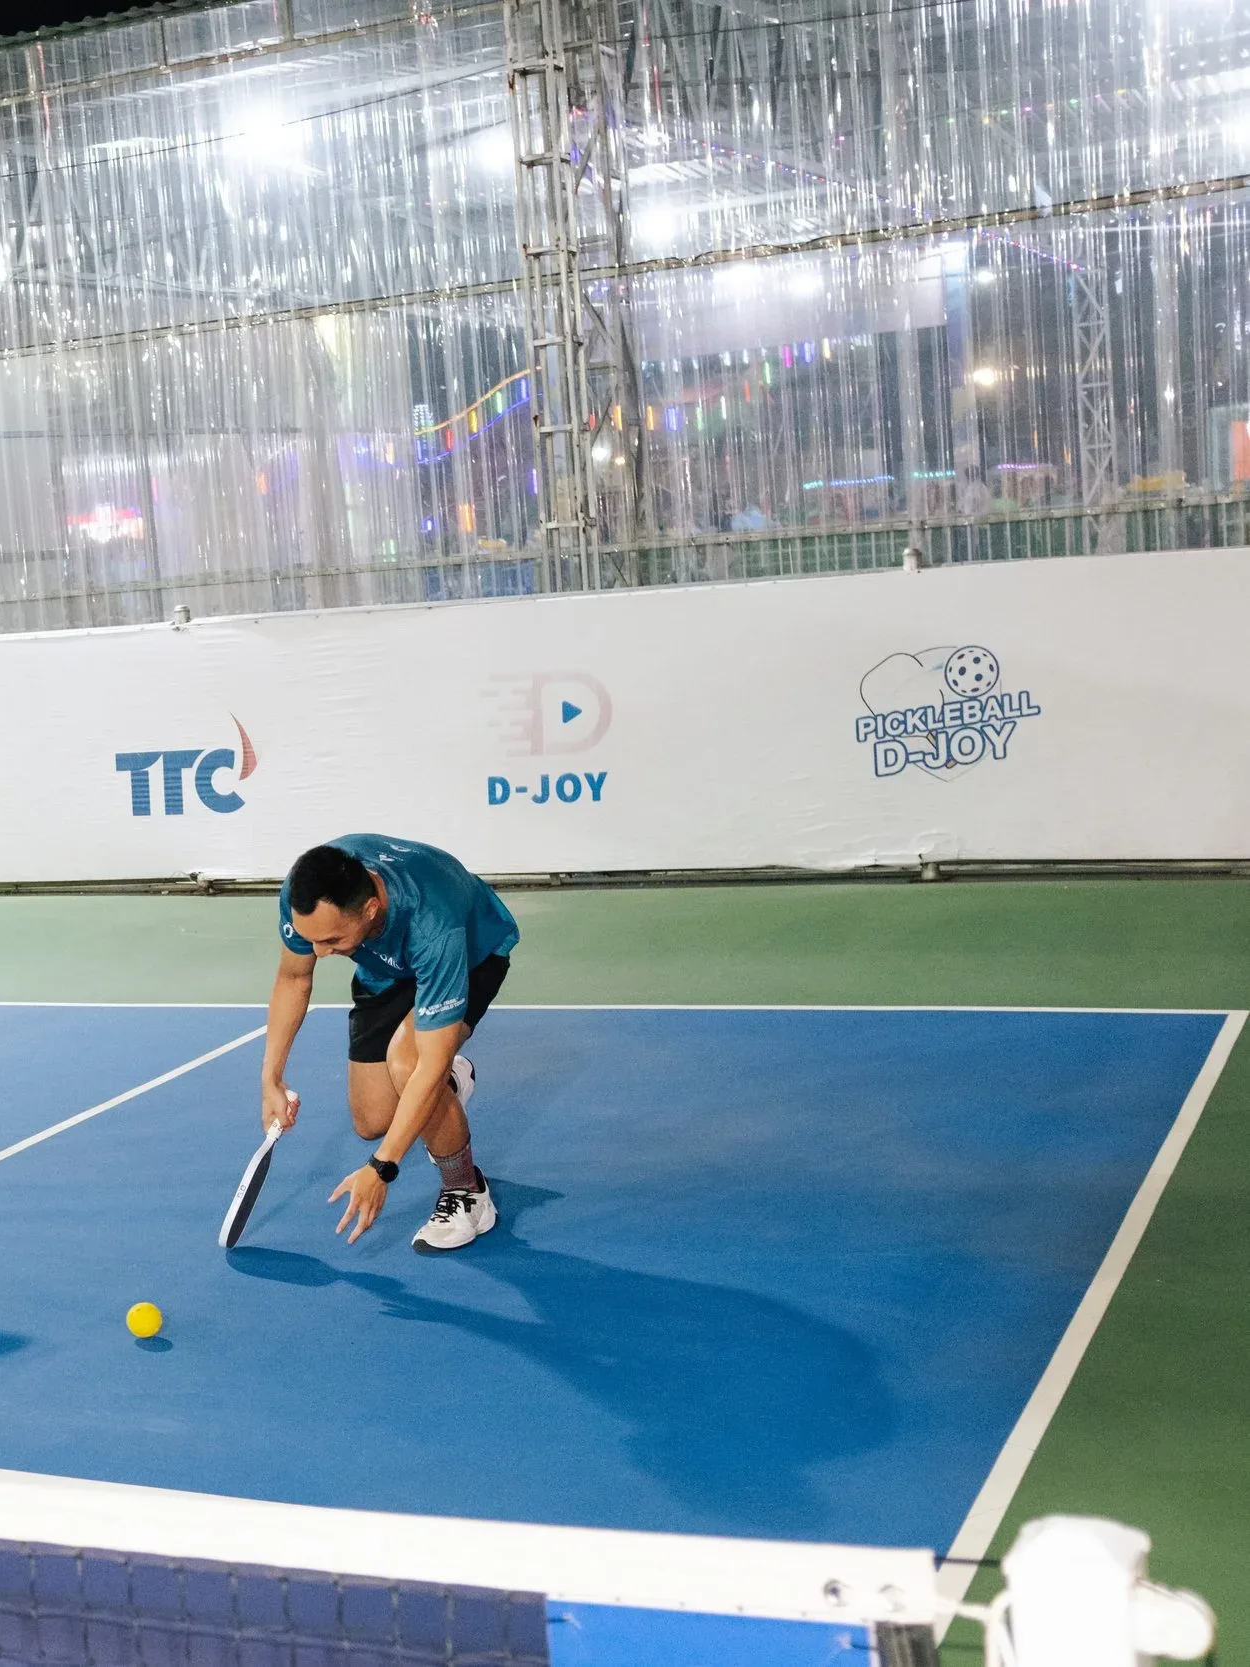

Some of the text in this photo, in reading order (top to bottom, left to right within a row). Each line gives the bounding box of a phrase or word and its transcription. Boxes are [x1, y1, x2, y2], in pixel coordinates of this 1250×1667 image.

[856, 690, 1040, 743] PICKLEBALL
[873, 720, 1017, 778] D-JOY
[115, 748, 246, 817] TTC
[487, 771, 608, 806] D-JOY
